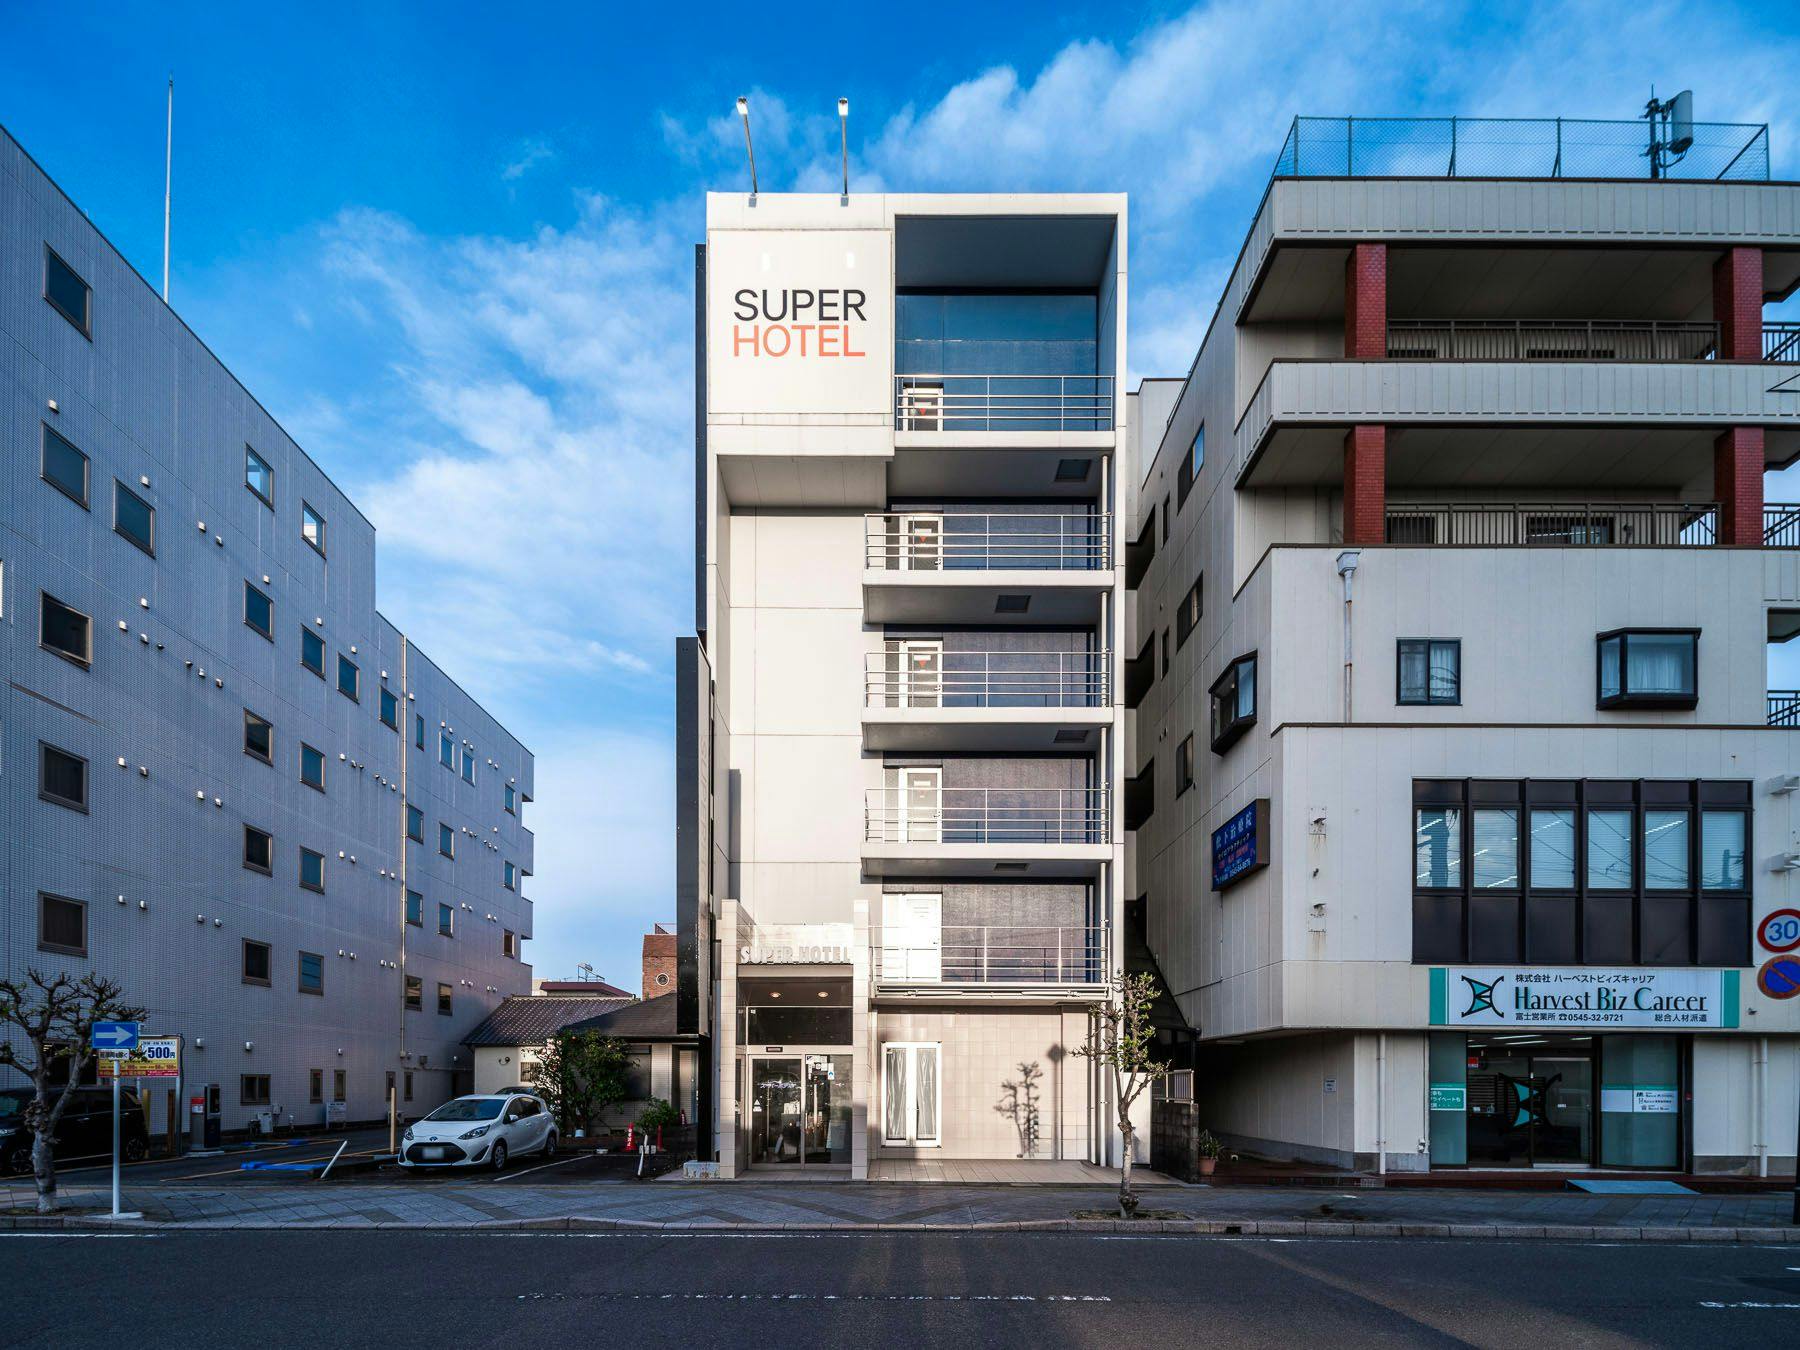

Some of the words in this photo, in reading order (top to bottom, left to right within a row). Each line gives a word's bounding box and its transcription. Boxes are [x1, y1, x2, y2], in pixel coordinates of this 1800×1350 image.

[734, 289, 867, 322] SUPER
[734, 324, 866, 357] HOTEL
[1769, 920, 1799, 942] 30
[740, 946, 793, 963] SUPER
[799, 945, 851, 962] HOTEL
[1515, 974, 1551, 983] 株式会社
[1554, 974, 1655, 983] ハーベストビィズキャリア
[1515, 986, 1592, 1010] Harvest
[1597, 987, 1628, 1010] Biz
[1634, 987, 1708, 1010] Career
[1515, 1012, 1556, 1021] 富士営業所
[1568, 1013, 1624, 1022] 0545-32-9721
[1654, 1013, 1707, 1022] 総合人材派遣
[147, 1046, 176, 1059] 500円
